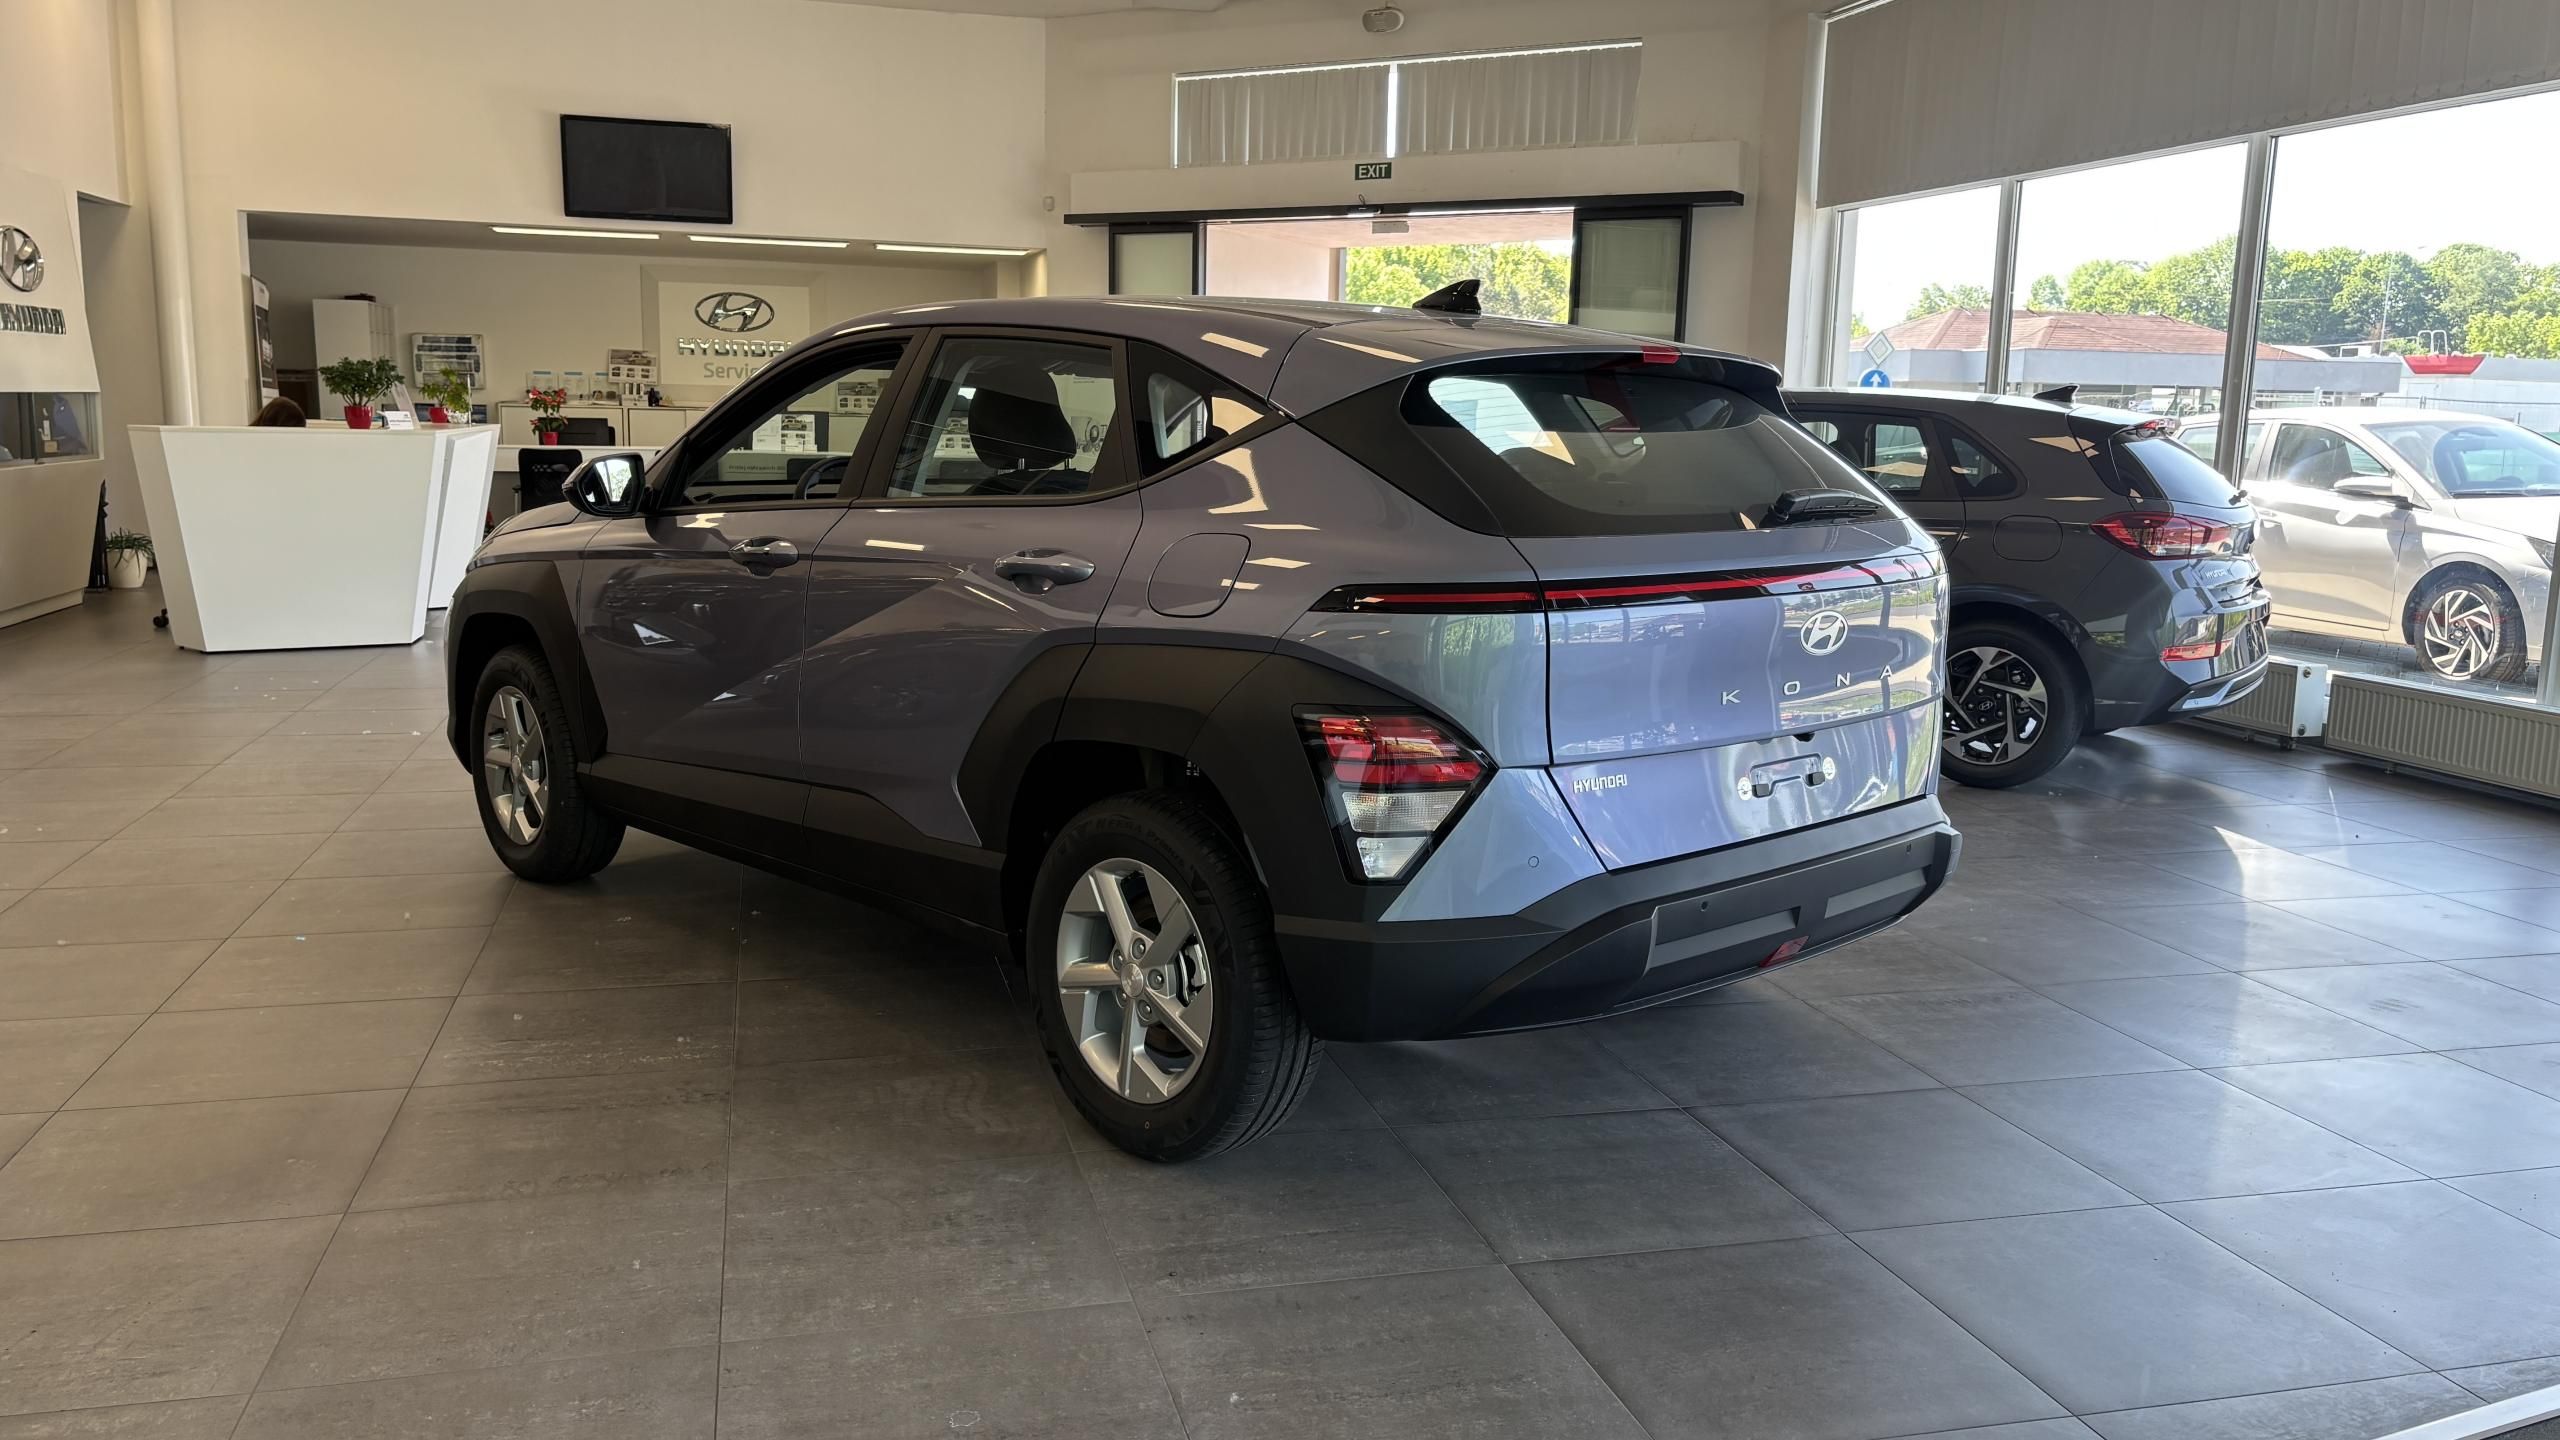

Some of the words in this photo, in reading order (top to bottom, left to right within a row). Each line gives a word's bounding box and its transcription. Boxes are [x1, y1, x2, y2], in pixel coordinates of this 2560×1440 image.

[1358, 164, 1388, 179] EXIT
[1720, 664, 1893, 706] KONA
[1573, 773, 1628, 794] HYUNDAI
